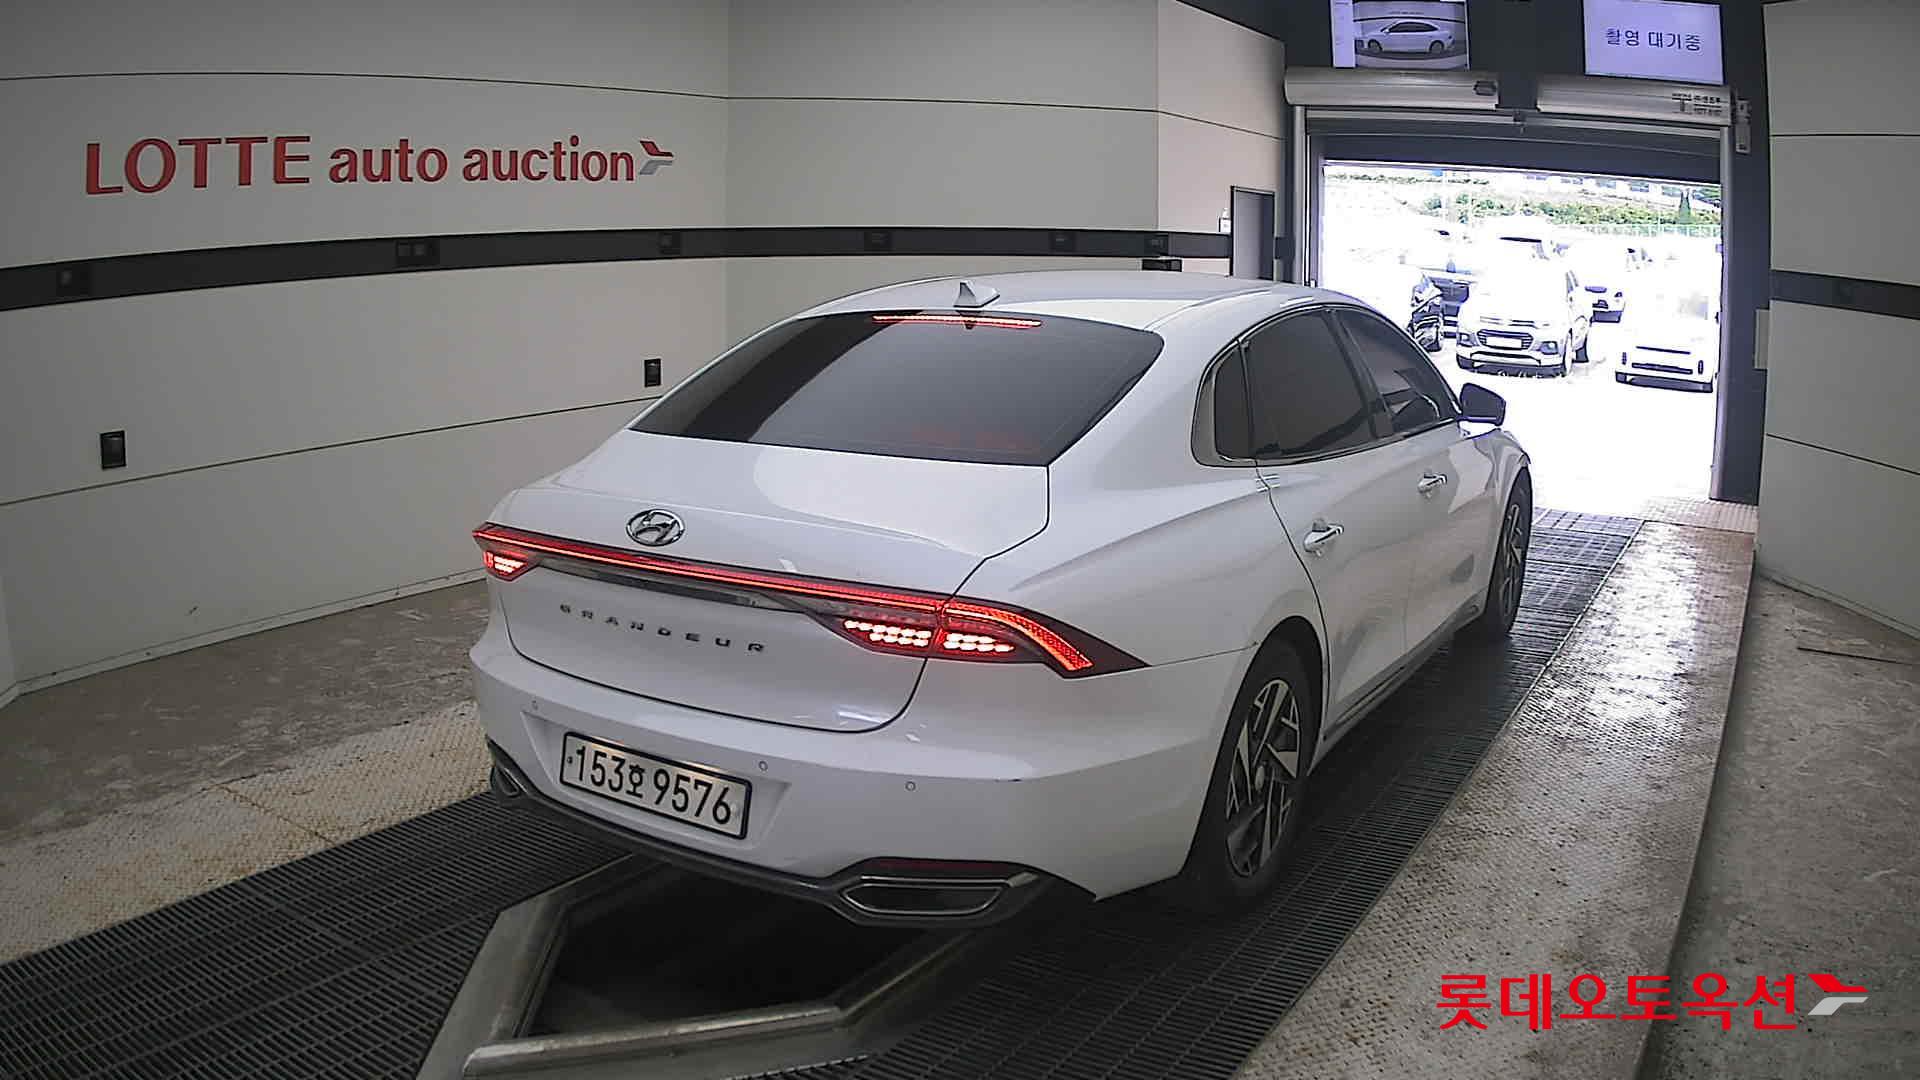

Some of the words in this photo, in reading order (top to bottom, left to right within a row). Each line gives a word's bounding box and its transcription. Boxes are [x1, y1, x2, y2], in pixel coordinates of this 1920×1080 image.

[1648, 31, 1701, 52] 대기중
[86, 136, 311, 195] LOTTE
[329, 139, 449, 183] auto
[463, 135, 635, 182] auction
[559, 604, 766, 654] GRANDEUR
[653, 769, 732, 825] 9576
